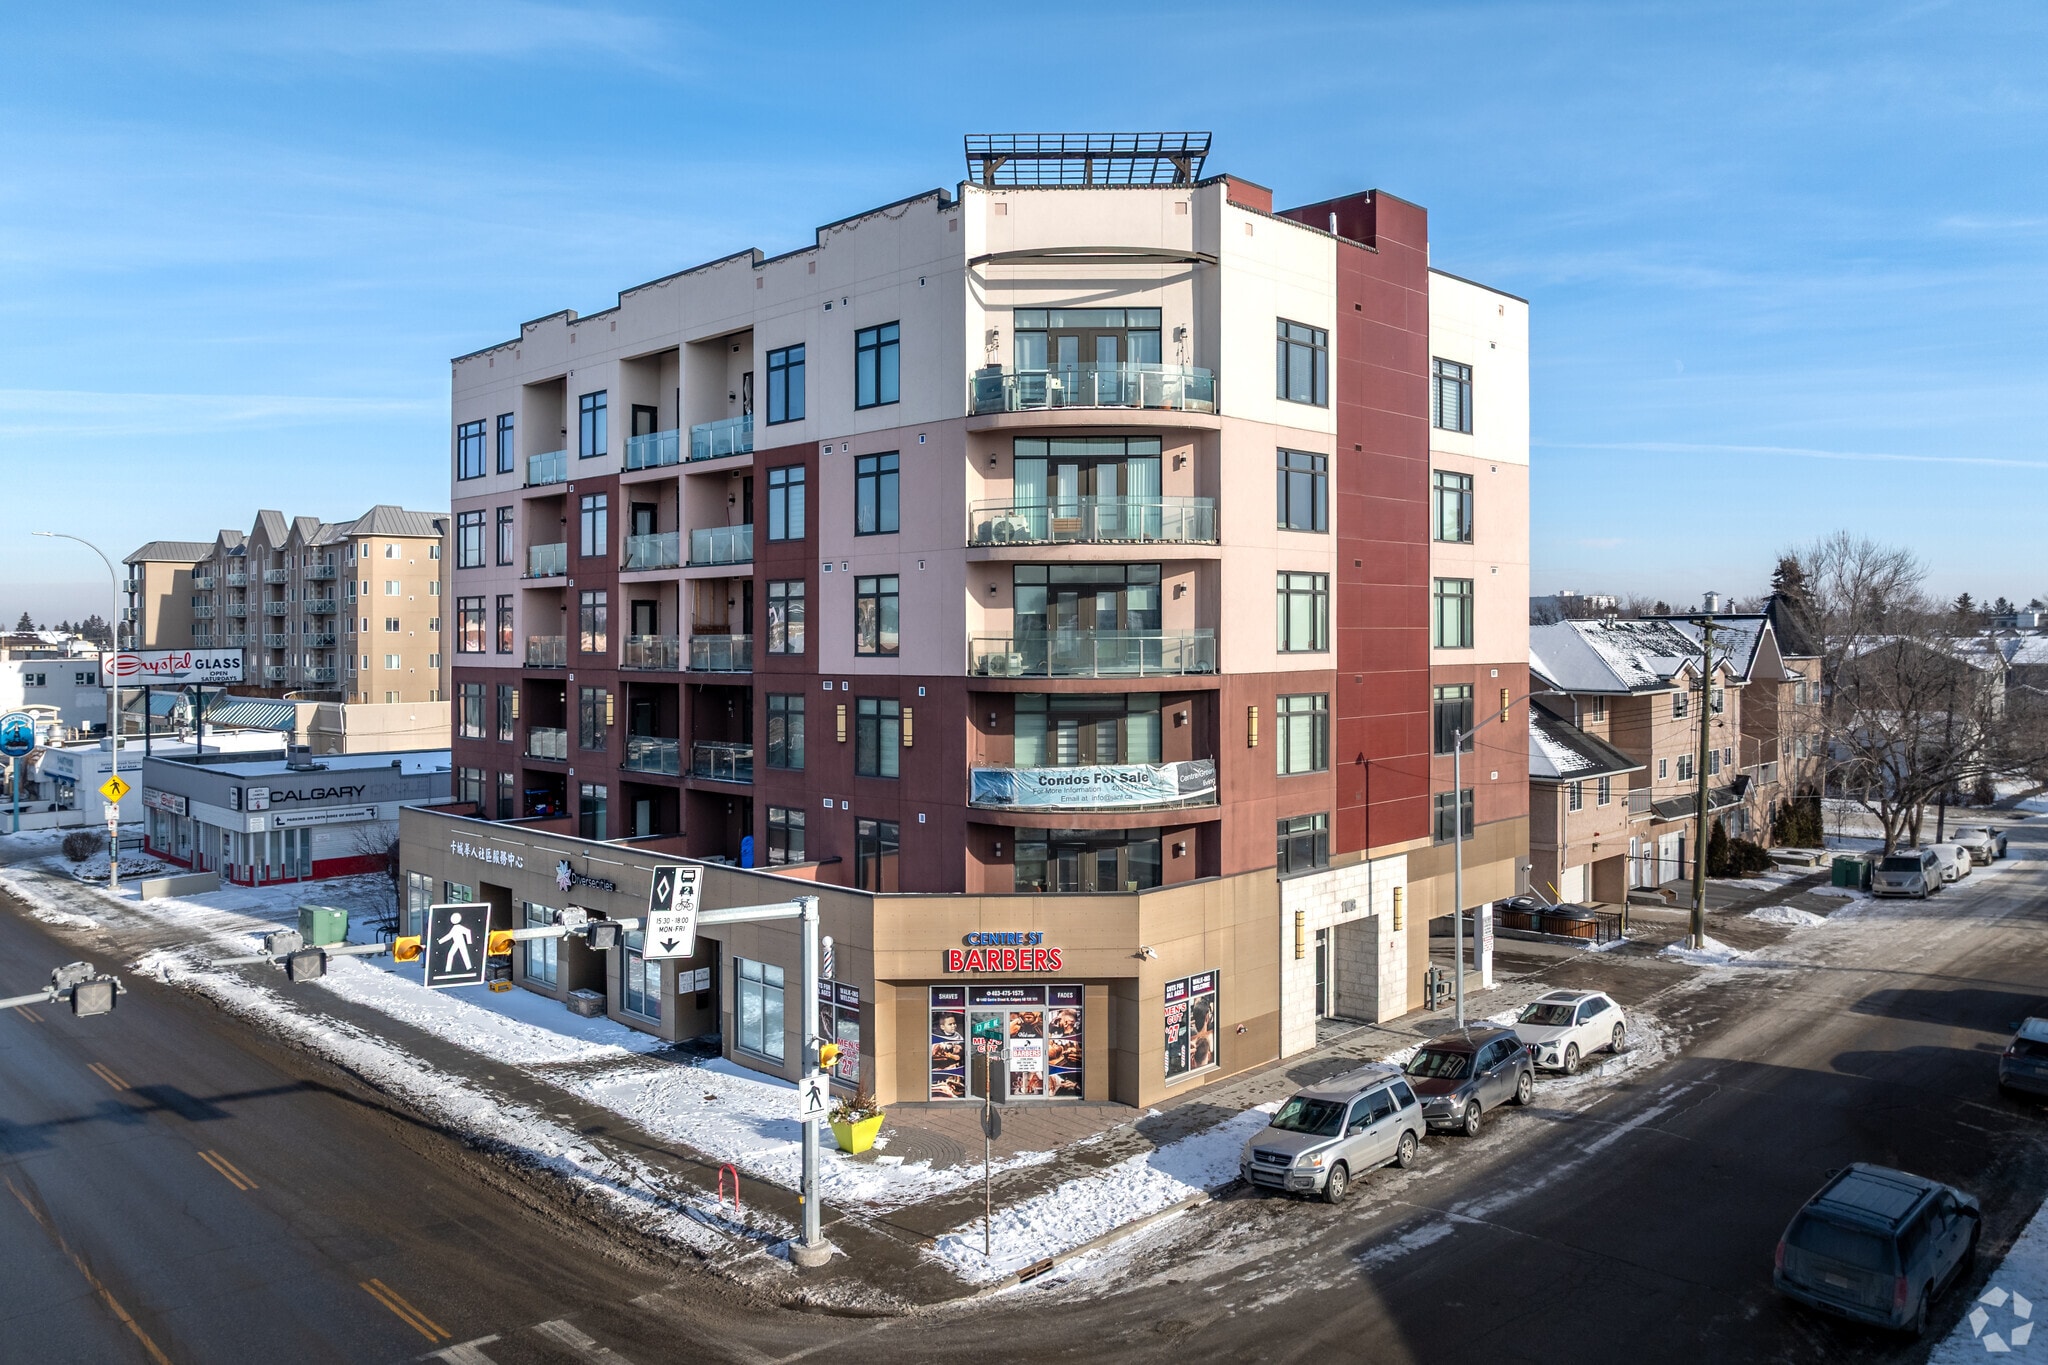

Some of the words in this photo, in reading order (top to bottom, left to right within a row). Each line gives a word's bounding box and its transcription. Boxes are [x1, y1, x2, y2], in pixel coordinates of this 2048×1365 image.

[195, 658, 240, 669] GLASS
[1038, 775, 1090, 786] Condos
[1094, 773, 1116, 784] For
[1120, 772, 1149, 783] Sale
[270, 785, 366, 803] CALGARY
[1032, 787, 1044, 795] For
[1045, 786, 1062, 794] More
[1063, 785, 1102, 793] Information
[683, 886, 691, 894] 2
[967, 931, 1024, 945] CENTRE
[1028, 931, 1044, 945] ST
[948, 947, 1063, 972] BARBERS
[1057, 991, 1074, 999] FADES
[1165, 1003, 1187, 1017] MEN'S
[1167, 1013, 1183, 1025] CUT
[837, 1038, 860, 1051] MEN'S
